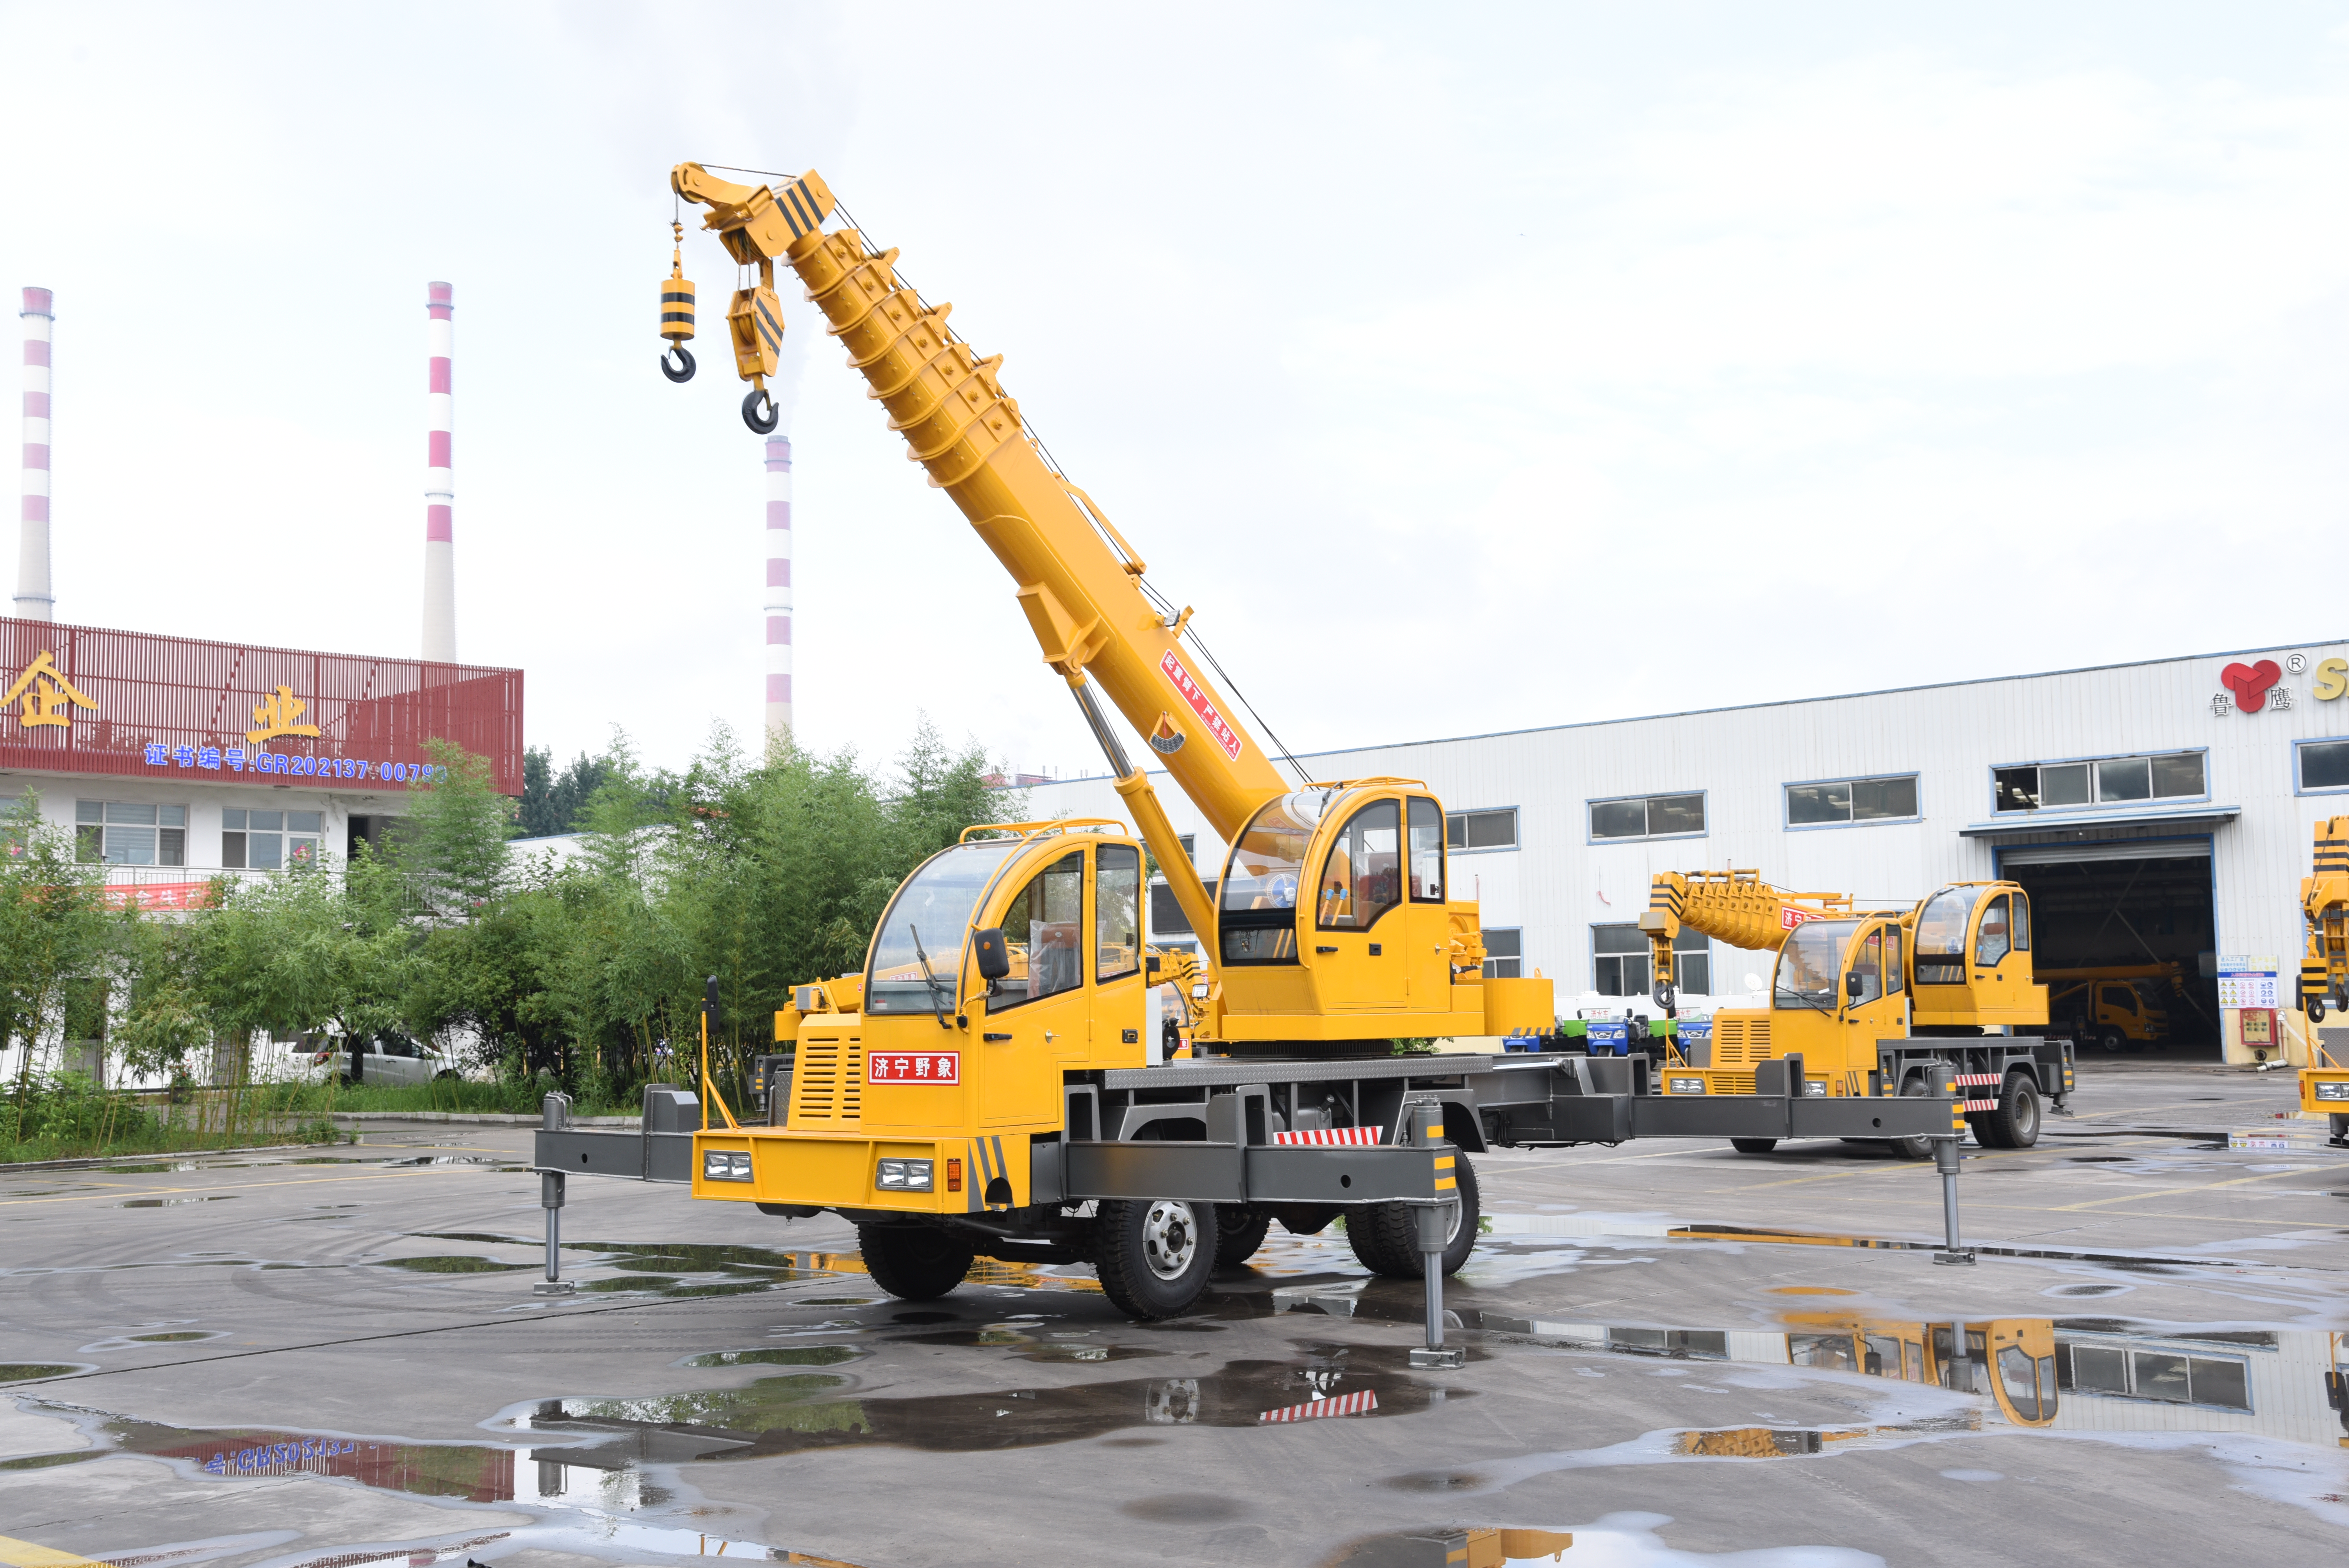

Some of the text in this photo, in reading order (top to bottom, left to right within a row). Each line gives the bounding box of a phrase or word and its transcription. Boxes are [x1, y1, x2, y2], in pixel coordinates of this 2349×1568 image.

[2313, 658, 2349, 701] S
[1164, 655, 1201, 700] 起重臂下
[1203, 704, 1237, 754] 严禁站人
[875, 1057, 952, 1078] 济宁野象
